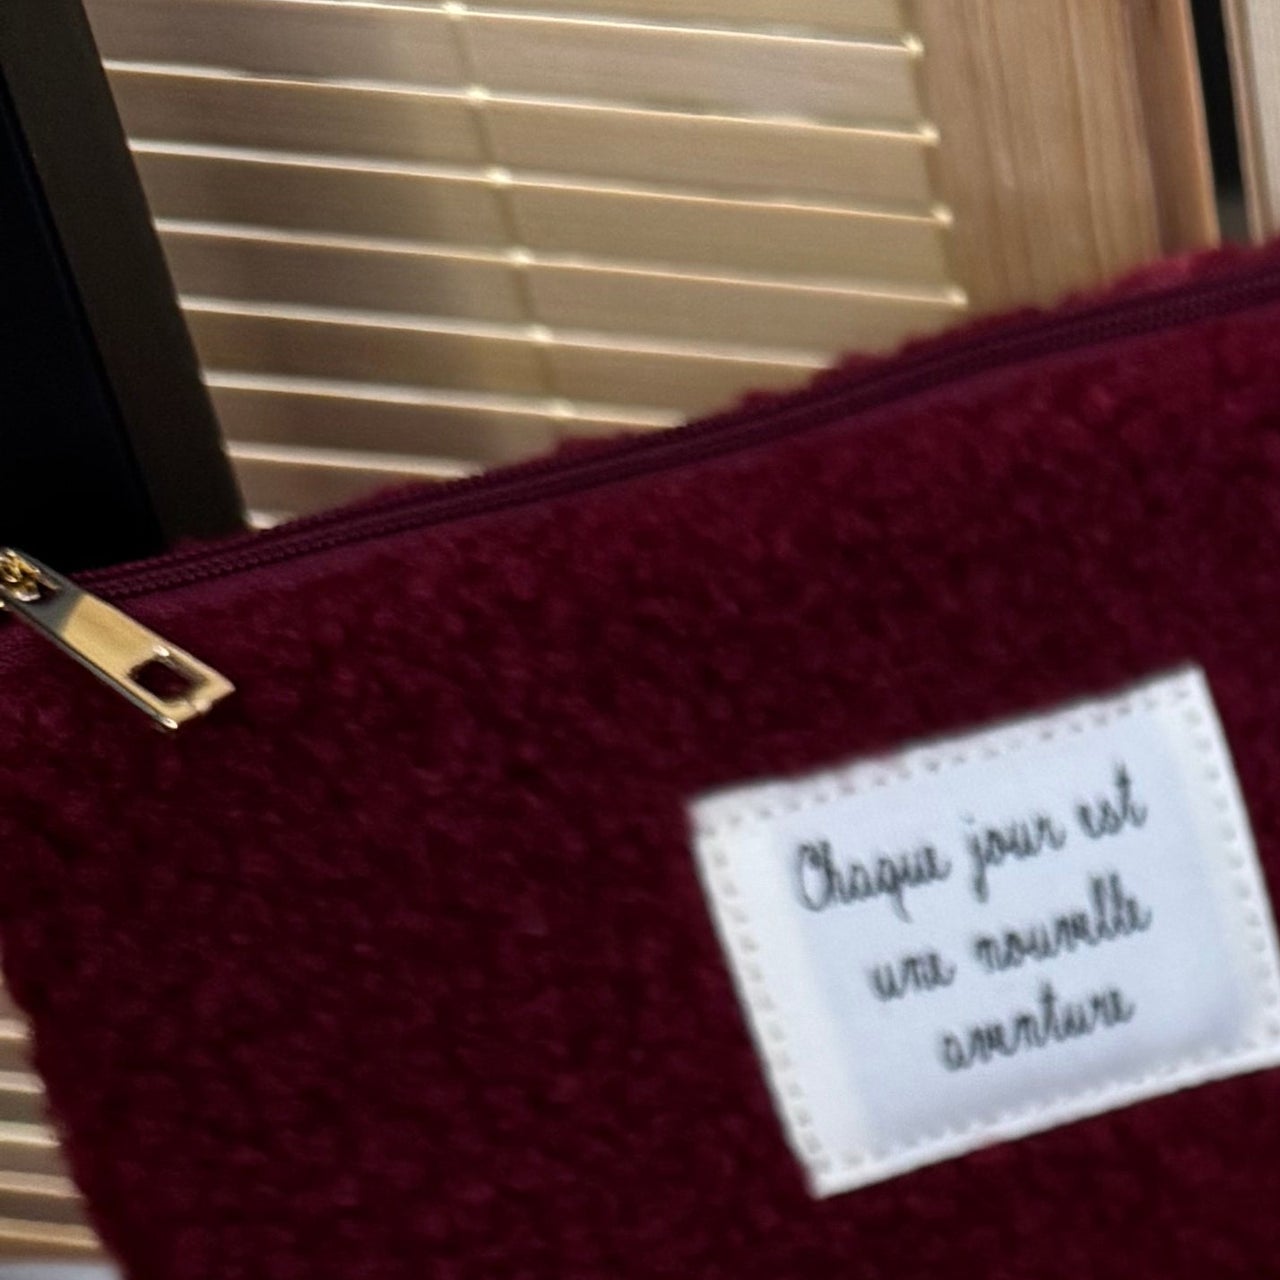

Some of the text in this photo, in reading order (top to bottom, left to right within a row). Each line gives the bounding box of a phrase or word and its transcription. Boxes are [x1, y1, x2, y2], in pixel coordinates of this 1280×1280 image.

[795, 760, 1148, 922] Chaque jour est
[869, 871, 1153, 1002] une nouvelle
[939, 980, 1136, 1071] aventure
